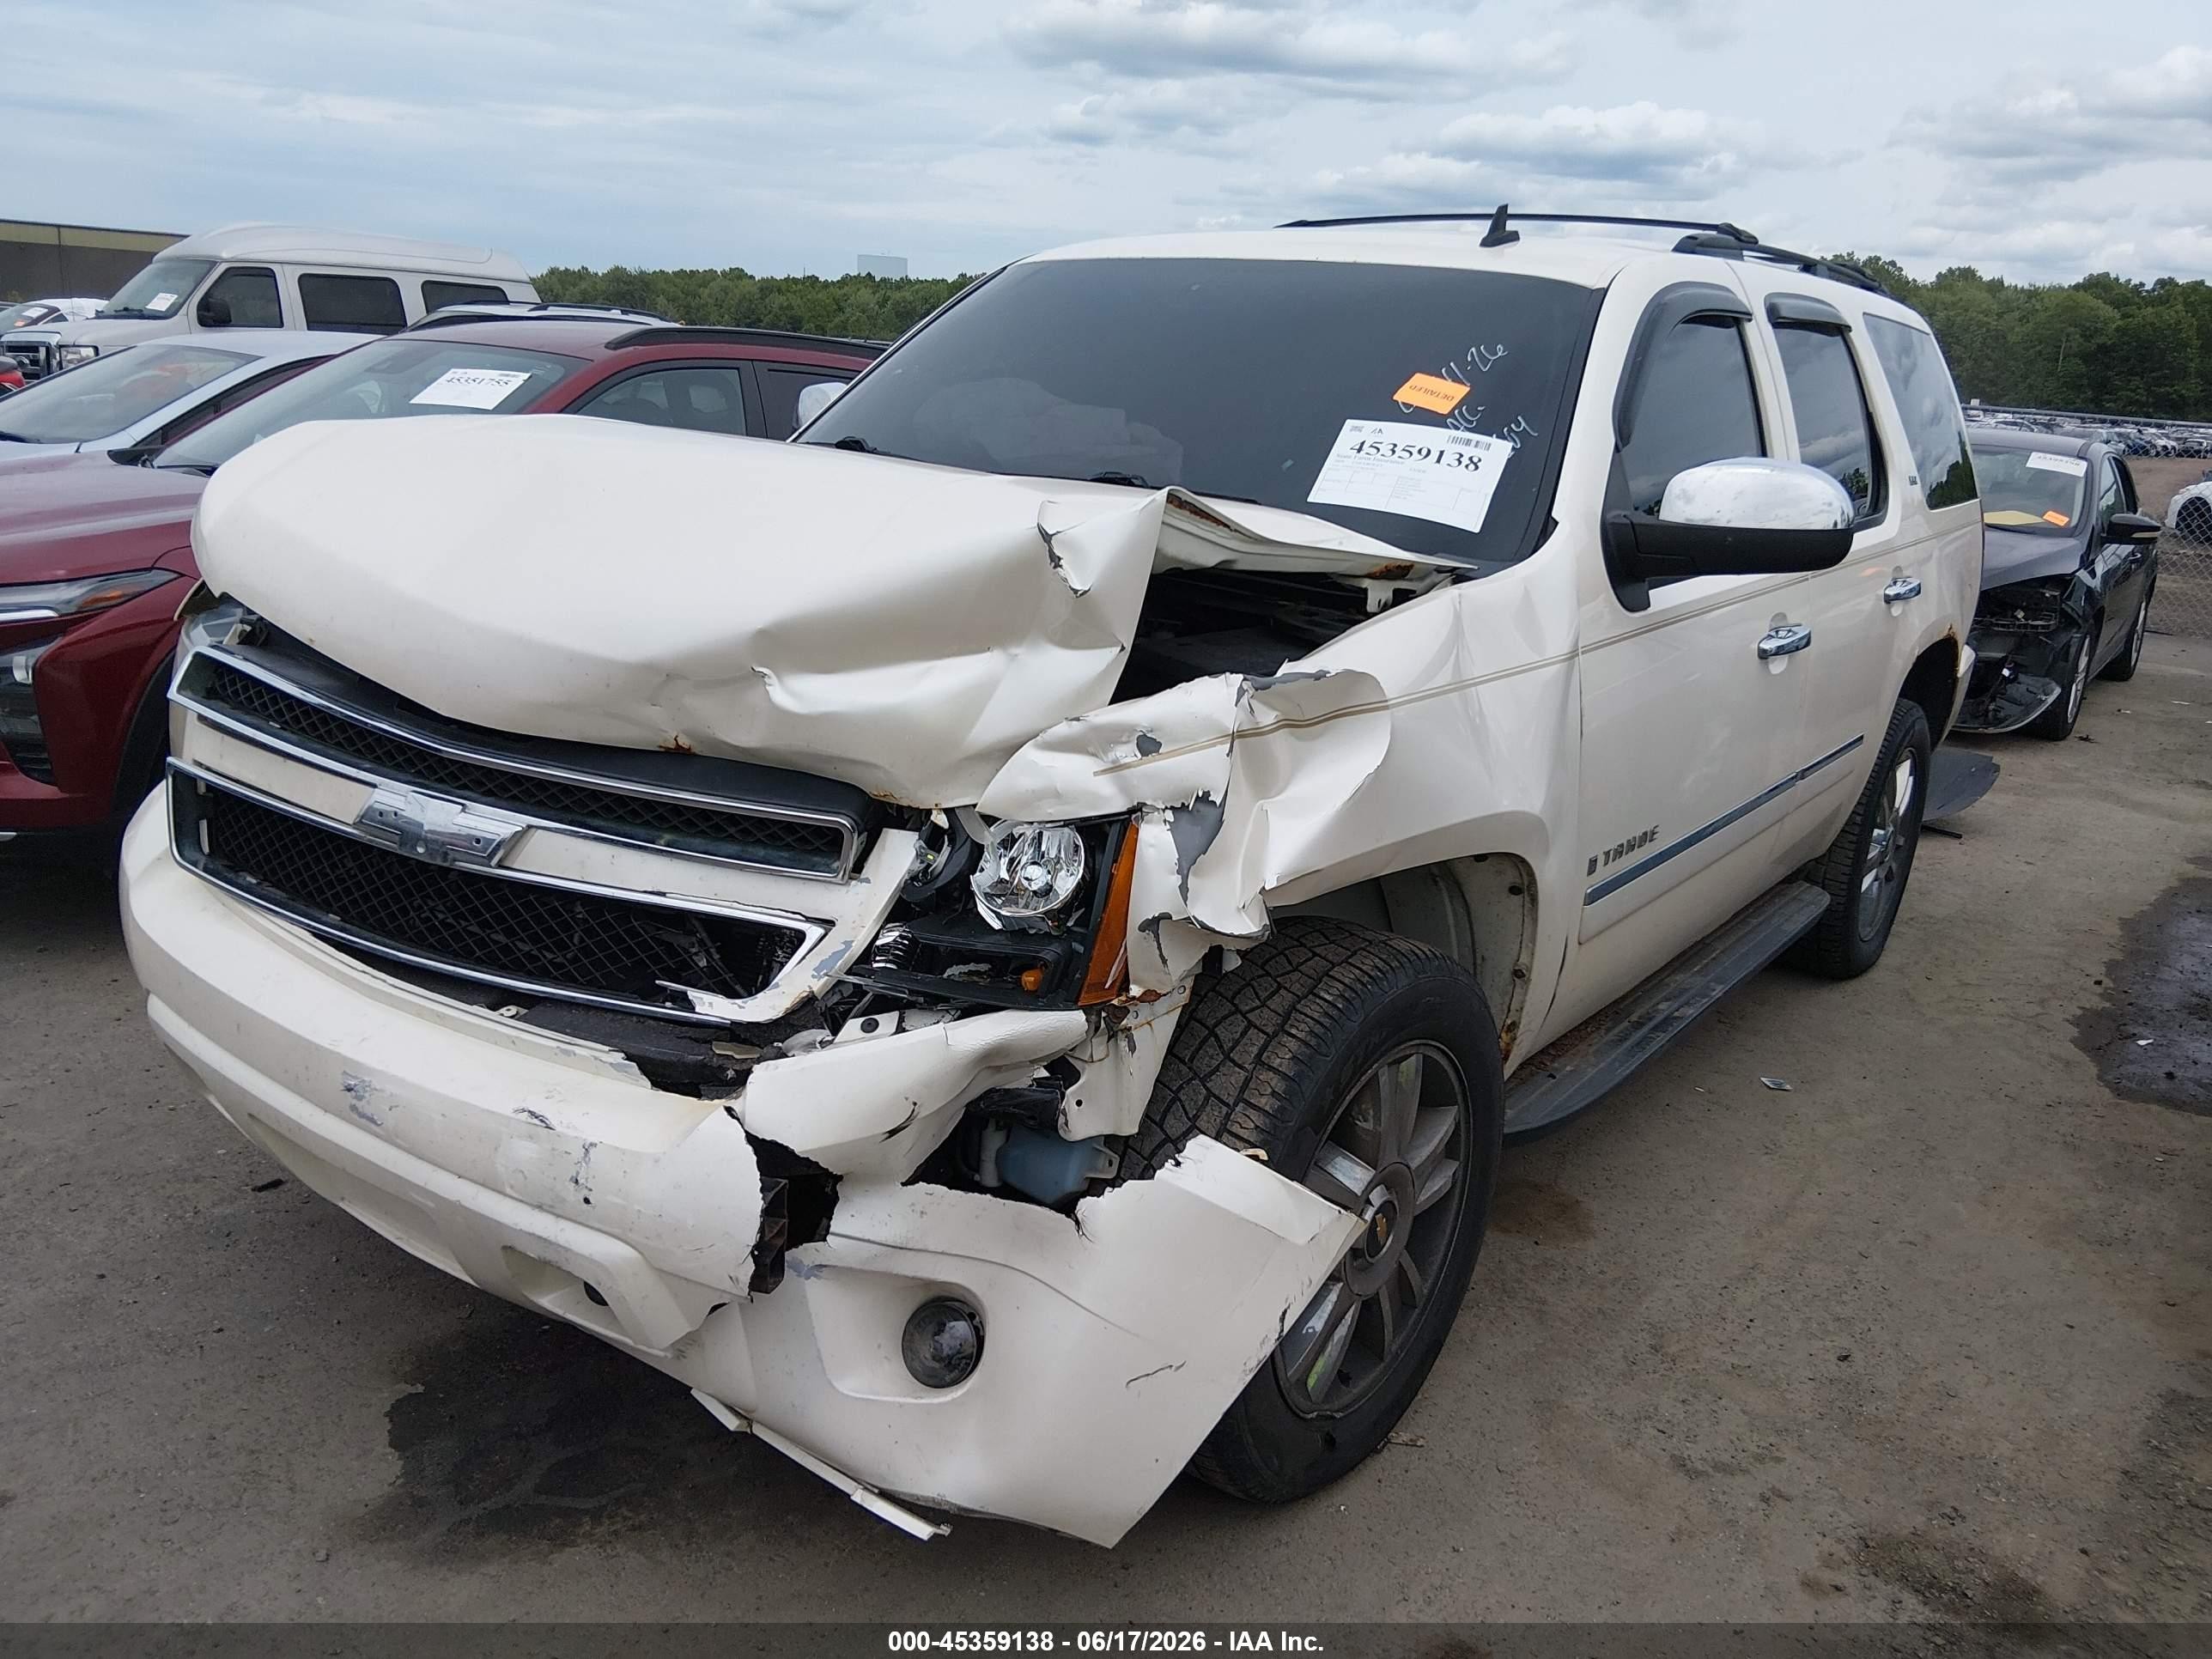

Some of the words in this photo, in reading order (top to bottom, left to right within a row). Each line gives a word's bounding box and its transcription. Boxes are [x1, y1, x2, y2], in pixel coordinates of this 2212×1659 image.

[1408, 384, 1455, 404] DETAILED
[1349, 439, 1483, 473] 45359138
[1602, 823, 1660, 867] TAHOE
